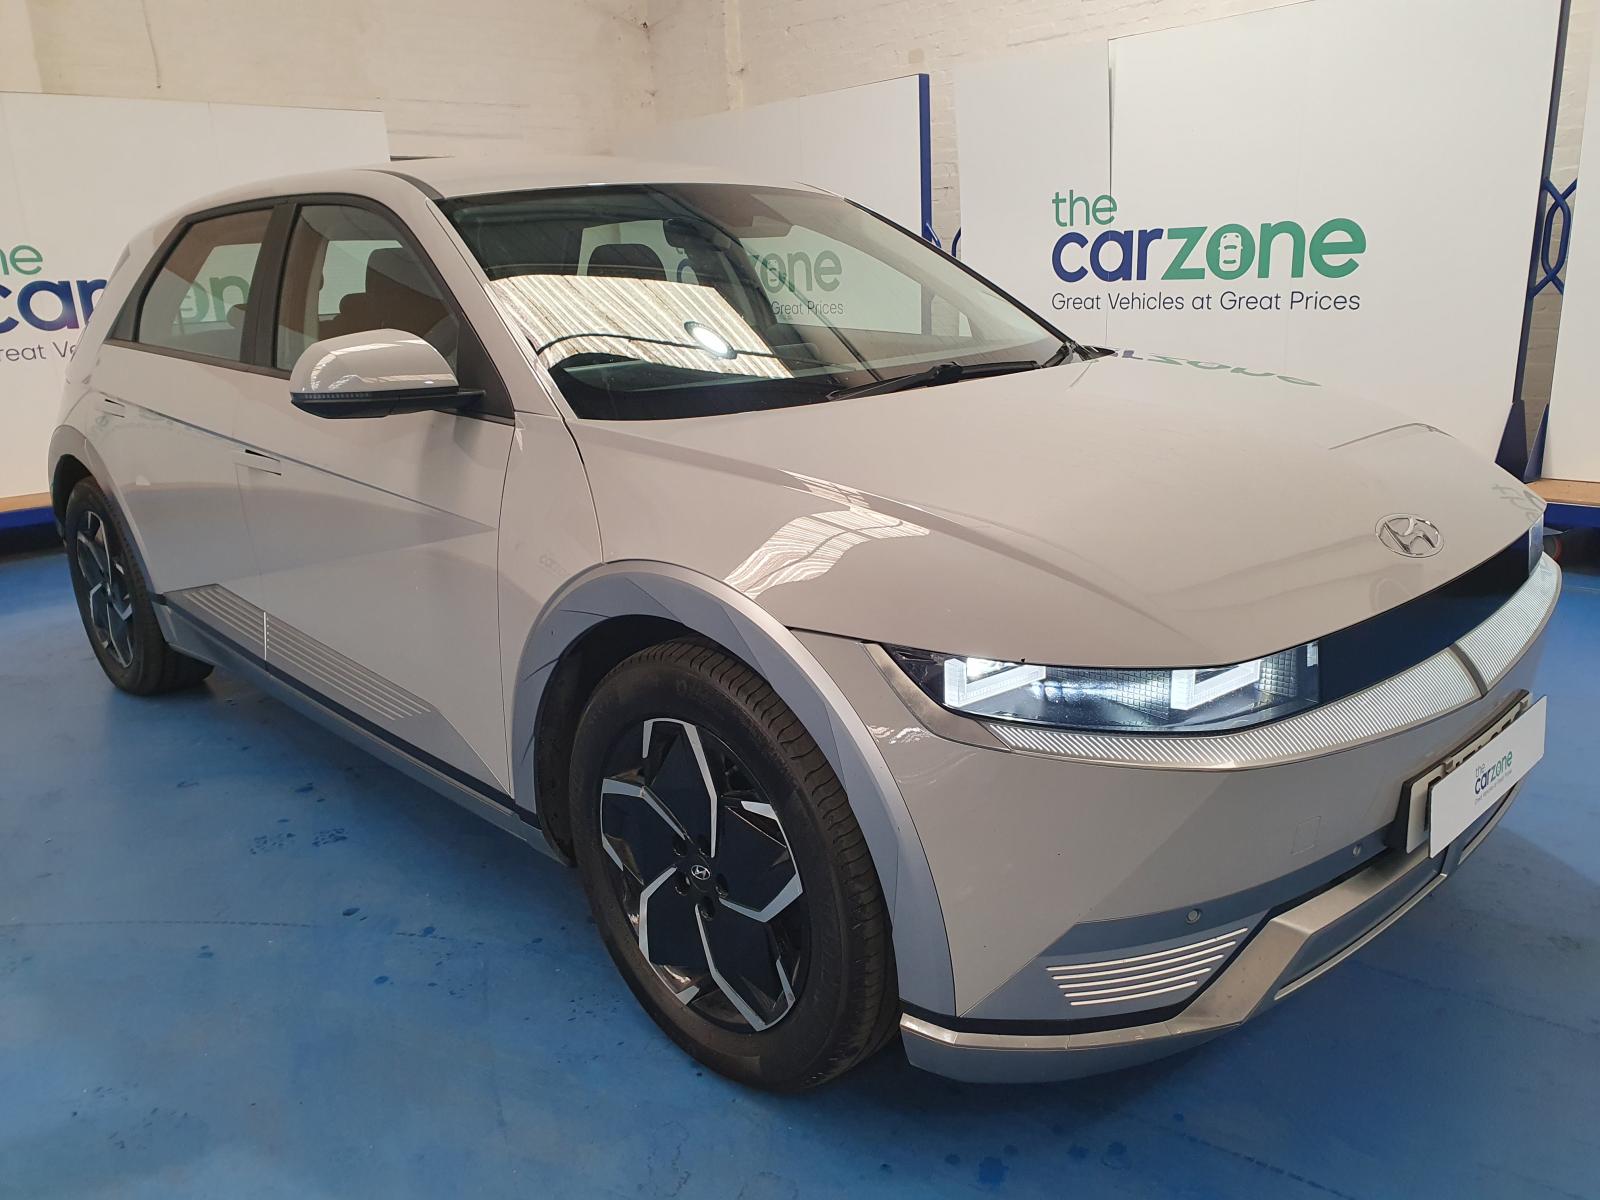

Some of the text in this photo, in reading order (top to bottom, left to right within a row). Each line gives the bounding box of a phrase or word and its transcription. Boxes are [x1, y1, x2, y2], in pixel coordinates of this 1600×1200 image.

[1052, 189, 1117, 227] the
[1051, 218, 1367, 283] carzone
[808, 300, 844, 315] Prices
[1051, 291, 1360, 311] Great Vehicles at Great Prices
[1475, 751, 1513, 794] carzone
